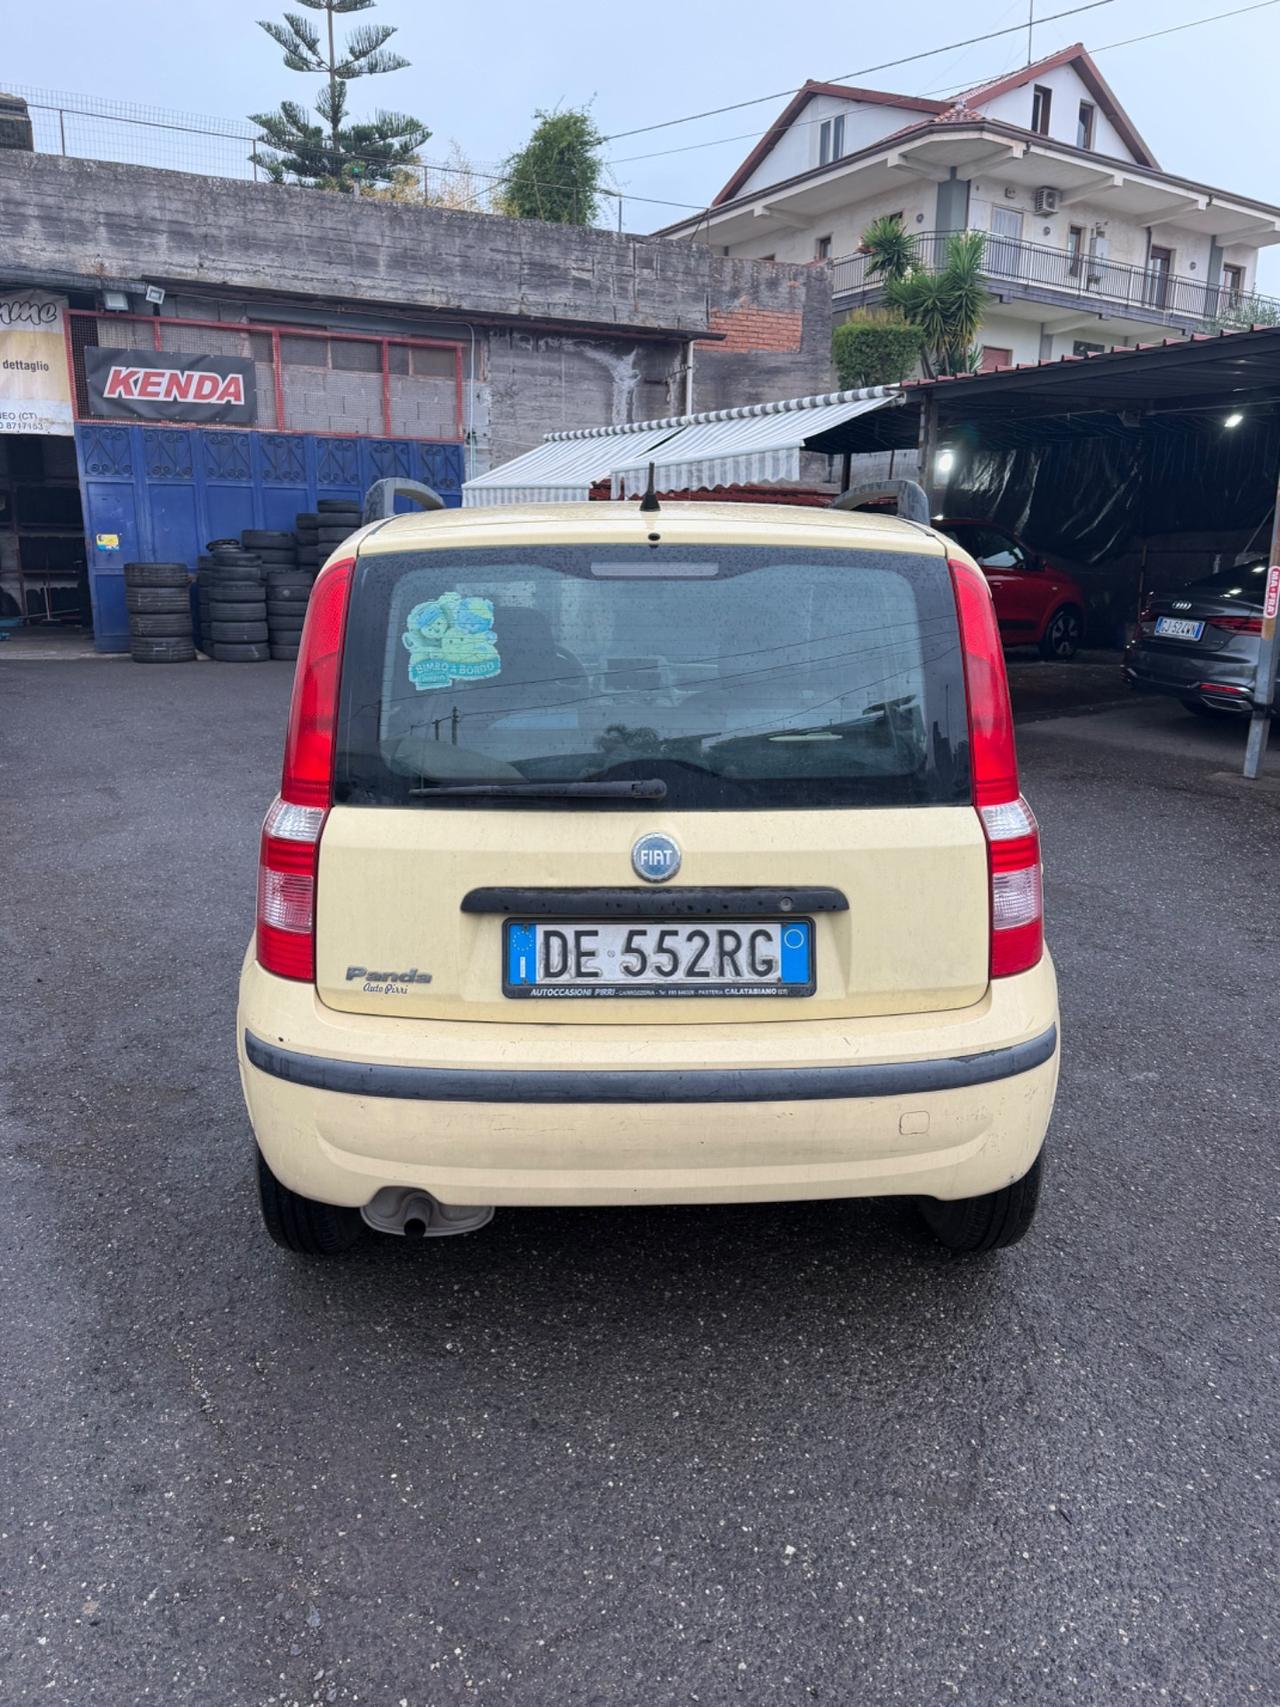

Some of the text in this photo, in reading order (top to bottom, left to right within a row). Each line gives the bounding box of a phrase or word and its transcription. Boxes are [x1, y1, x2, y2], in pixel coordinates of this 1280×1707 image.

[3, 359, 49, 373] dettaglio
[103, 366, 245, 405] KENDA
[640, 849, 673, 866] FIAT
[541, 929, 600, 978] DE
[621, 929, 775, 978] 552RG
[345, 966, 433, 984] Panda
[530, 988, 592, 997] AUTOCCASIONI
[594, 988, 616, 996] PIRRI
[724, 988, 777, 996] CALATABIANO
